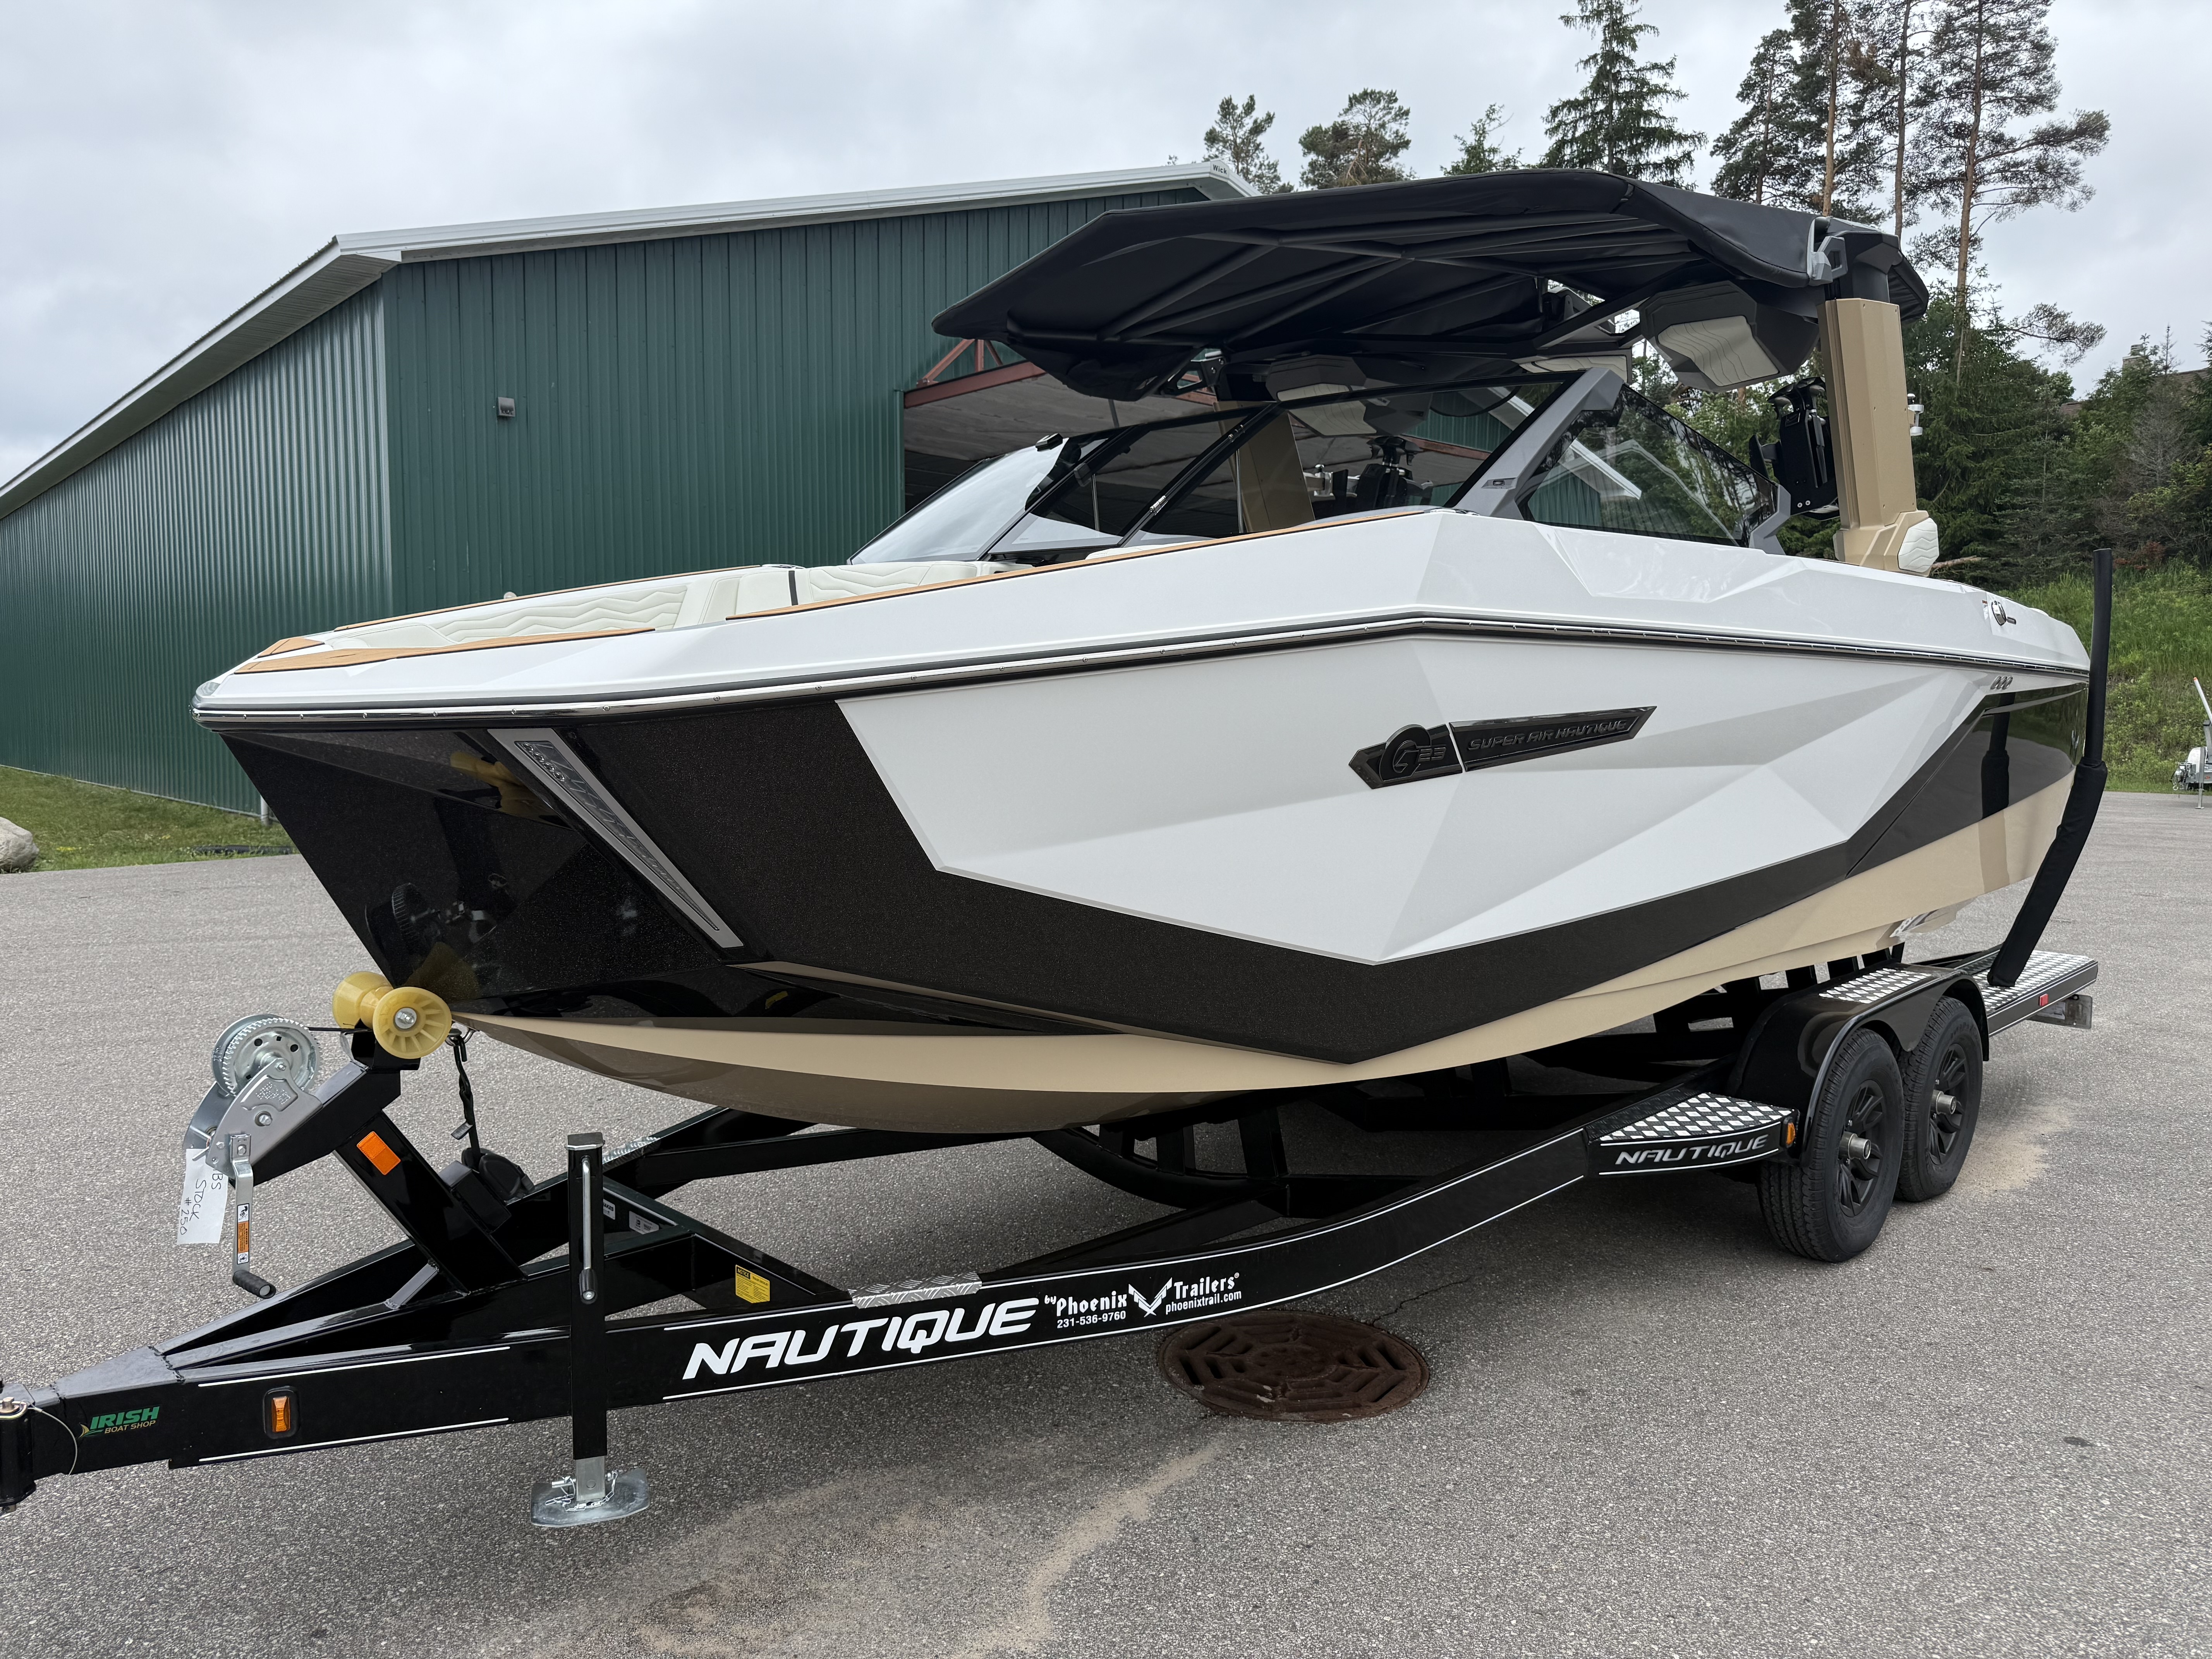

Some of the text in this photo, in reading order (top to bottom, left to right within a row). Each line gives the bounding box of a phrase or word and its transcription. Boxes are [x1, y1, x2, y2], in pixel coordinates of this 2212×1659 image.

[1213, 164, 1227, 175] Wick
[1468, 720, 1626, 750] SUPER AIR NAUTIQUE
[1615, 1134, 1769, 1164] NAUTIQUE
[189, 1179, 206, 1221] STOCK
[737, 1268, 750, 1278] NOTICE
[1044, 1295, 1057, 1305] by
[1056, 1290, 1127, 1316] Phoenix
[1166, 1290, 1242, 1315] phoenixtrail.com
[1057, 1310, 1126, 1328] 231-536-9760
[682, 1297, 1039, 1380] NAUTIQUE
[90, 1406, 160, 1429] IRISH
[105, 1420, 156, 1434] BOAT SHOP
